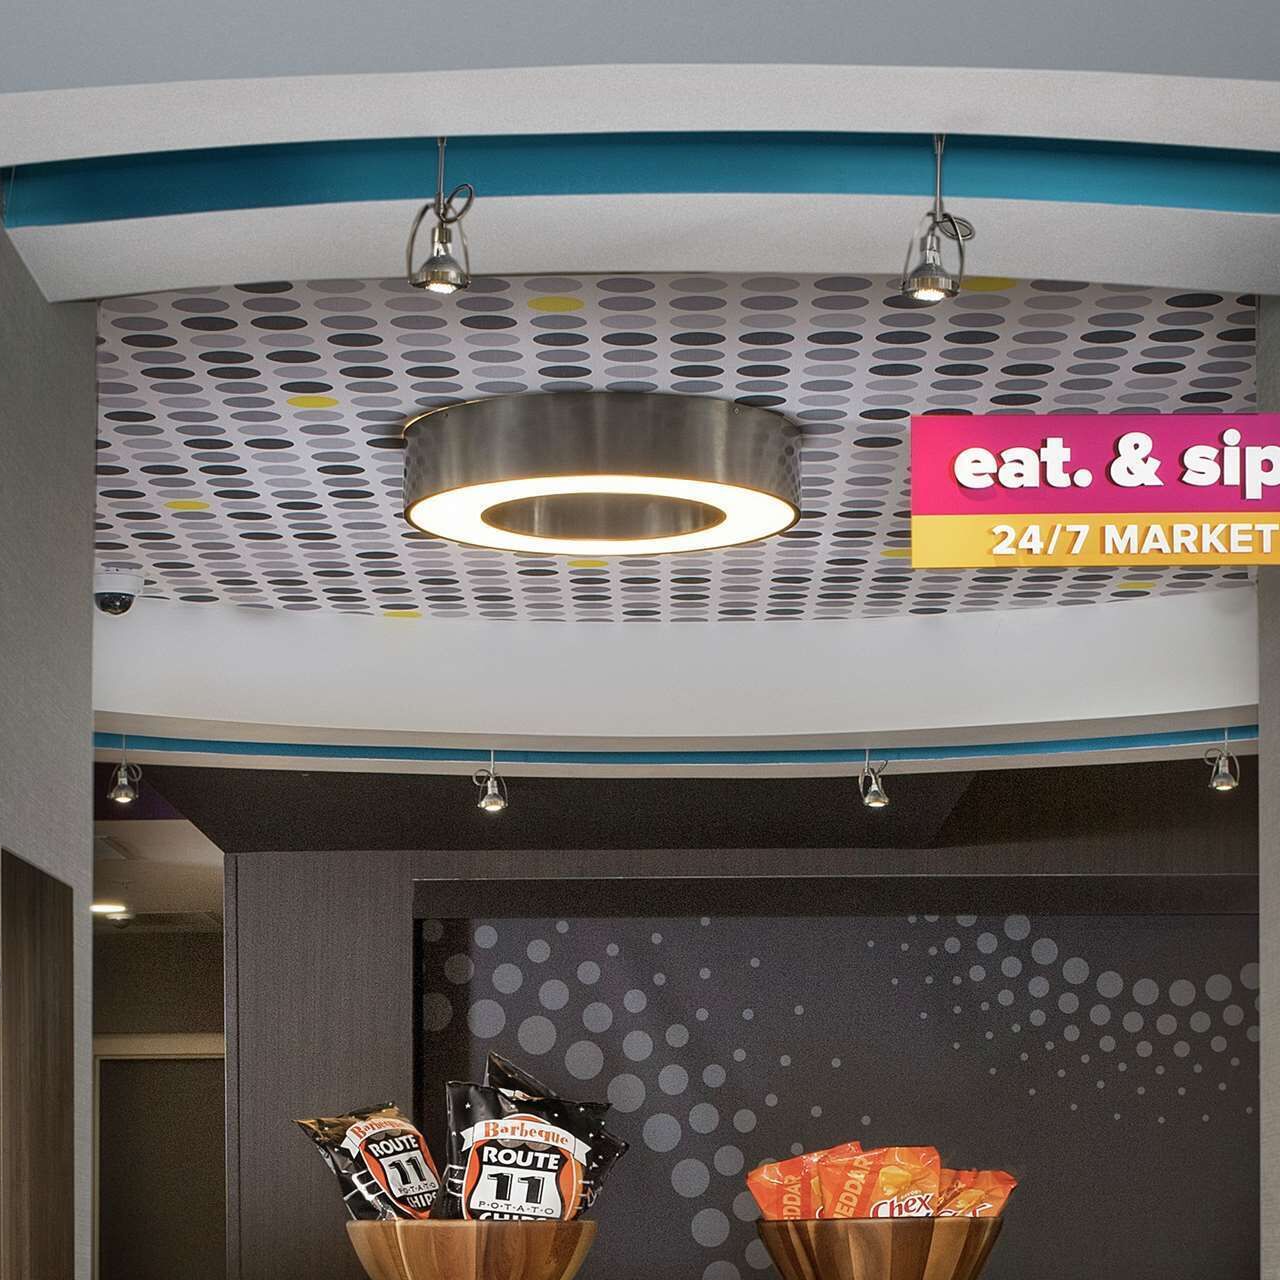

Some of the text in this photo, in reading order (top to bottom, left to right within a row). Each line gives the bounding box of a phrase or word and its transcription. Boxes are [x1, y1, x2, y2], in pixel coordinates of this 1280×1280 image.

[954, 437, 1093, 488] eat.
[1110, 431, 1164, 487] &
[991, 523, 1279, 555] 24/7 MARKET
[368, 1135, 419, 1157] ROUTE
[483, 1146, 560, 1170] ROUTE
[388, 1156, 427, 1185] 11
[487, 1173, 545, 1204] 11
[871, 1192, 936, 1217] Chex
